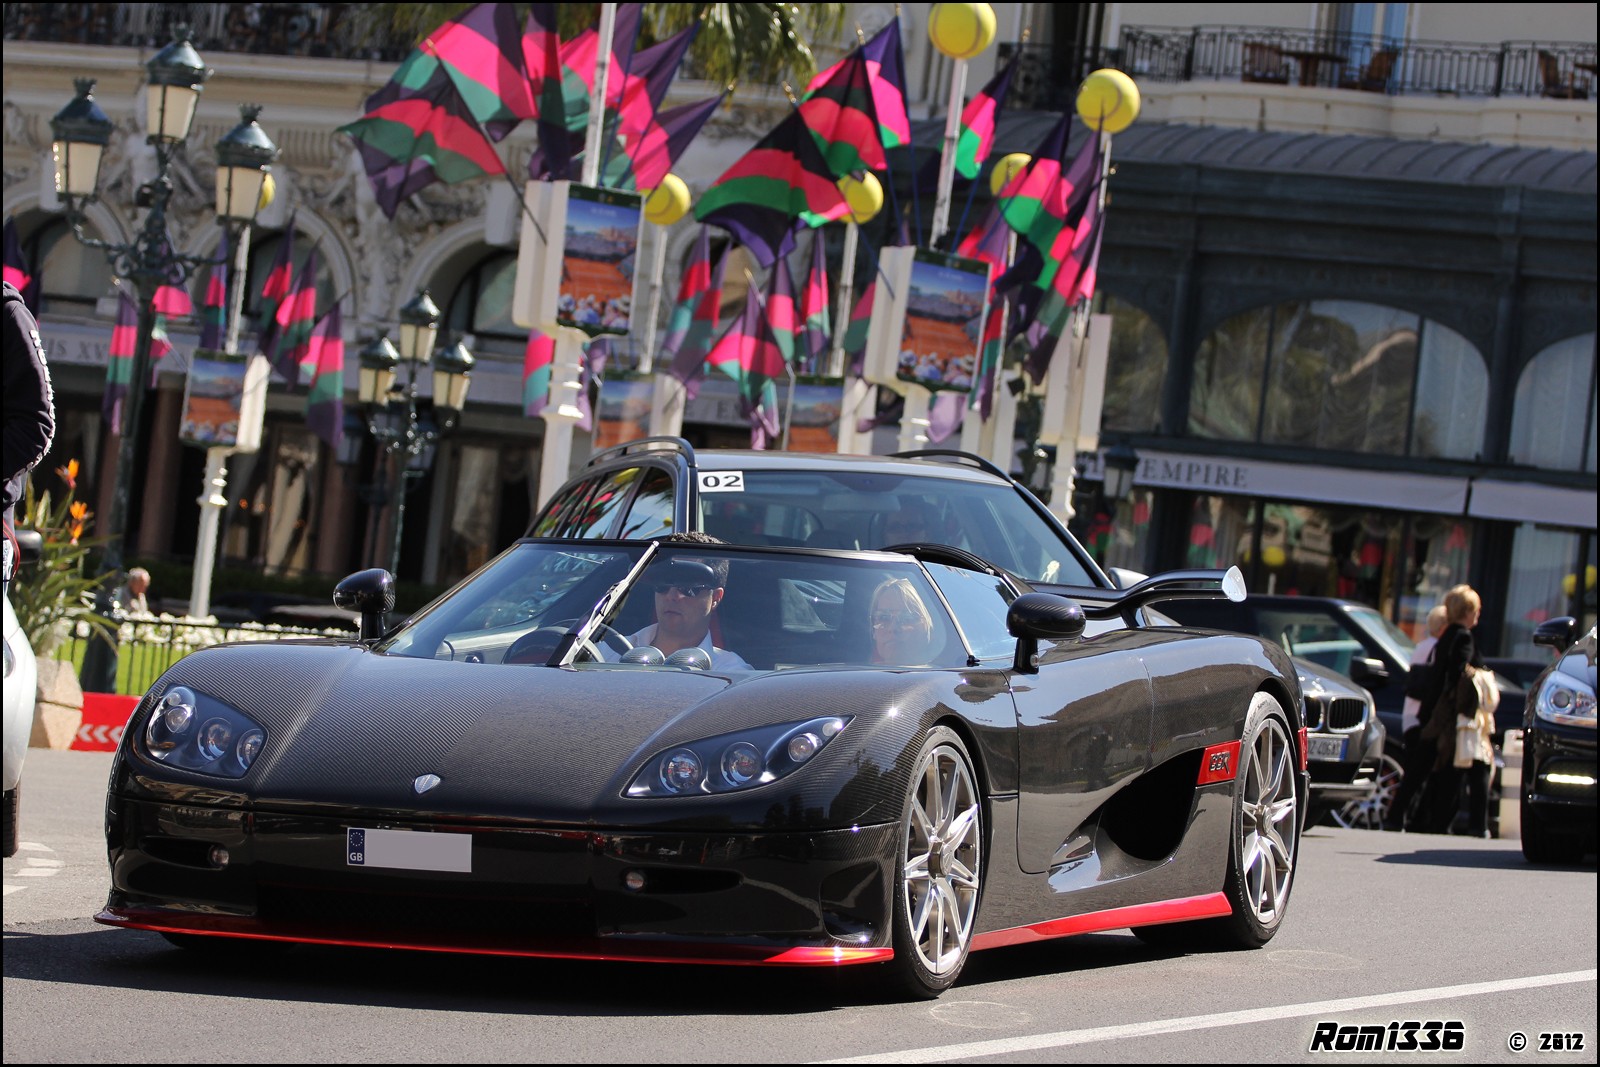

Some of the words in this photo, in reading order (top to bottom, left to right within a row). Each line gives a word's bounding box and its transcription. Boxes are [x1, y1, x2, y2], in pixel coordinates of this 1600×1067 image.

[1141, 457, 1249, 488] EMPIRE
[702, 475, 742, 488] 02
[349, 852, 363, 862] GB
